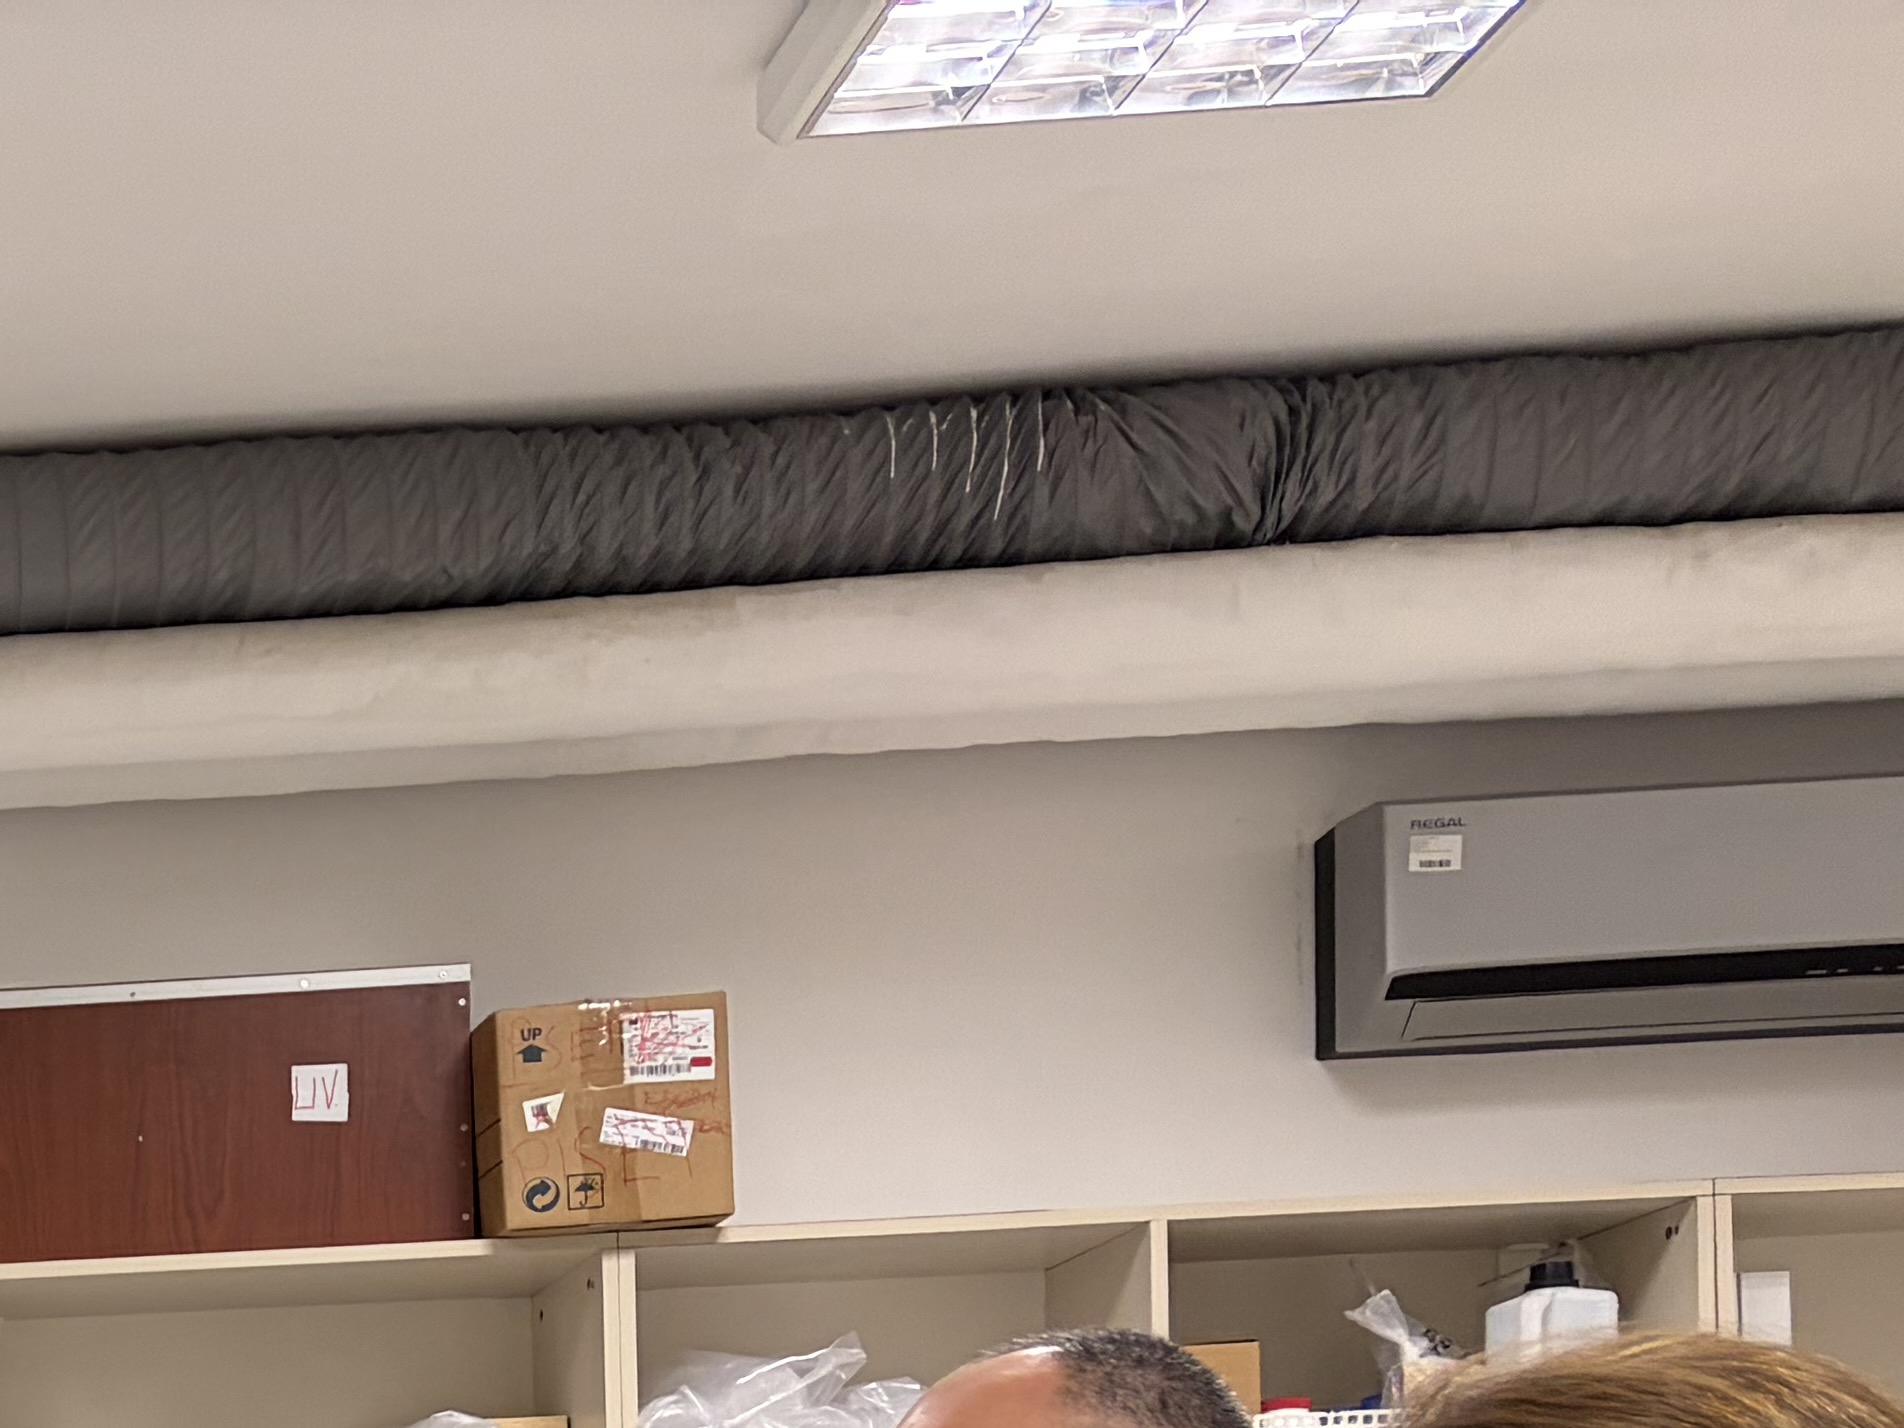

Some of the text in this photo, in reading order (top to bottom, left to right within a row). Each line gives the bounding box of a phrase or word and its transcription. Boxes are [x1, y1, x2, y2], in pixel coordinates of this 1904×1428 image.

[1410, 816, 1466, 830] REGAL
[520, 1027, 542, 1041] UP
[294, 1069, 339, 1111] UV
